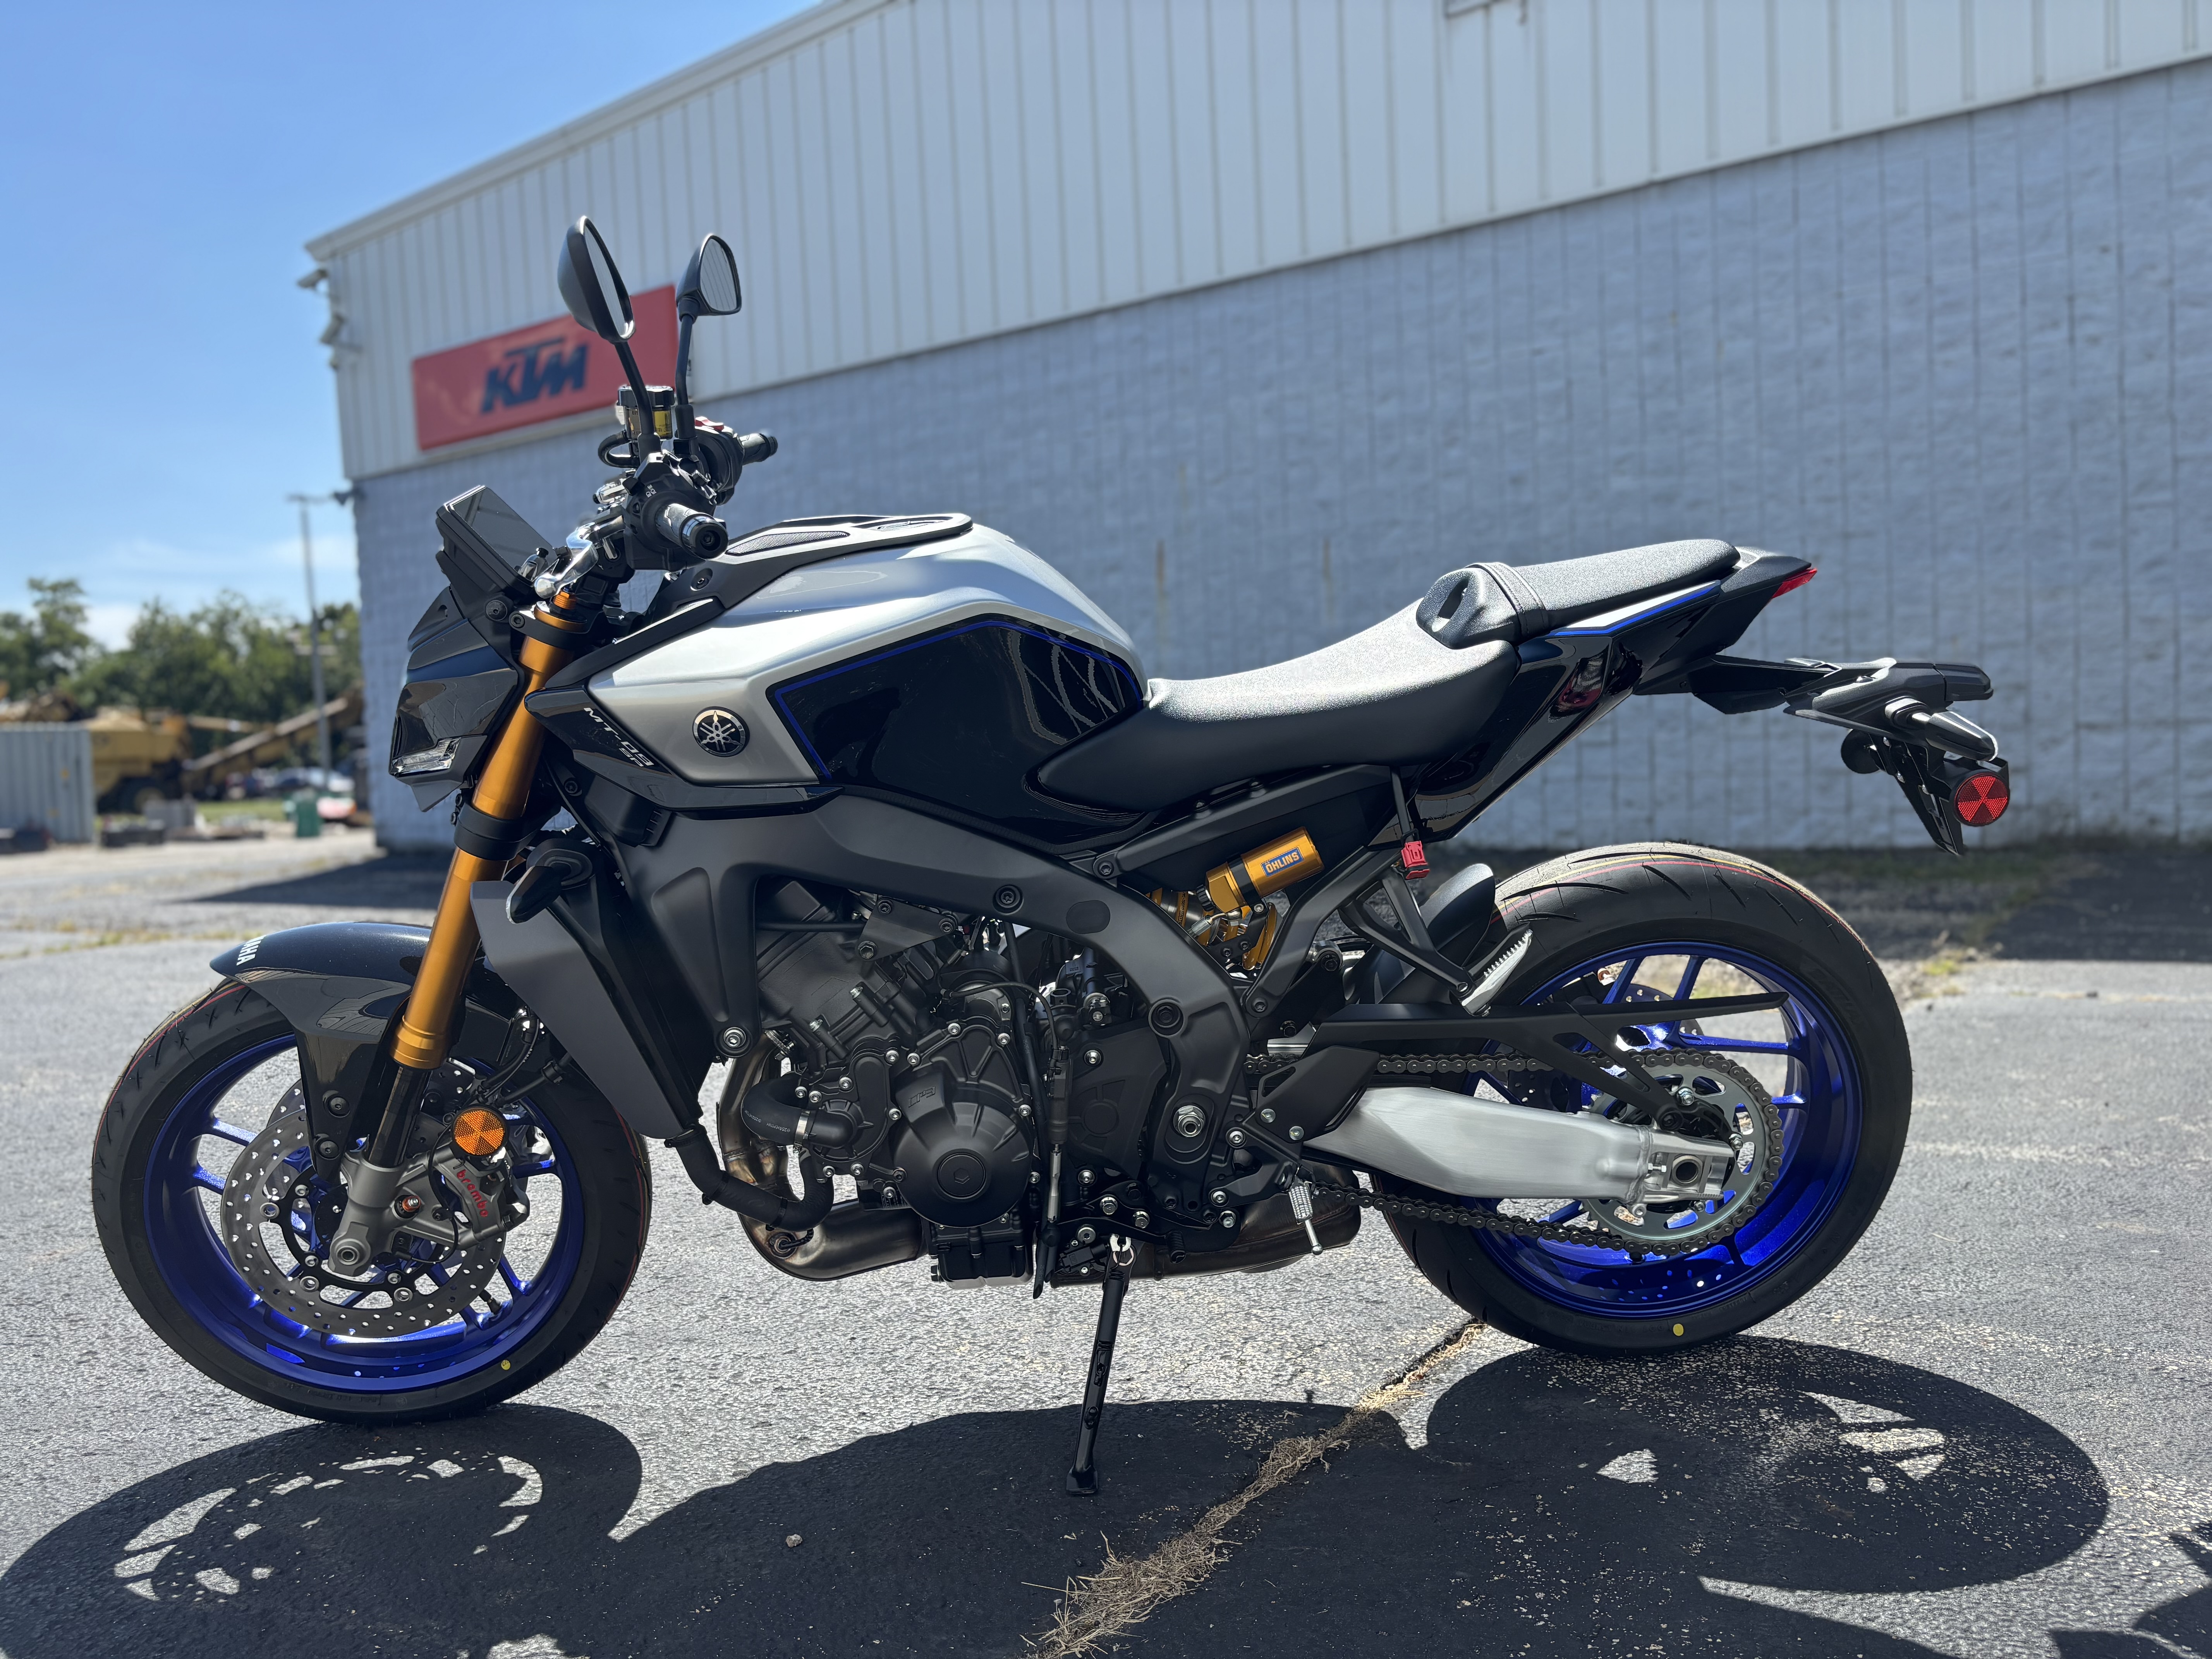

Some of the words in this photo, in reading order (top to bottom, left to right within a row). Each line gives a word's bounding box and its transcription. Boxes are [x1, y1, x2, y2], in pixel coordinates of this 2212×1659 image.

[482, 337, 587, 414] KTM
[584, 708, 654, 766] MT-09
[619, 748, 644, 767] SP
[1265, 852, 1300, 873] ÖHLINS
[457, 1169, 488, 1217] brembo
